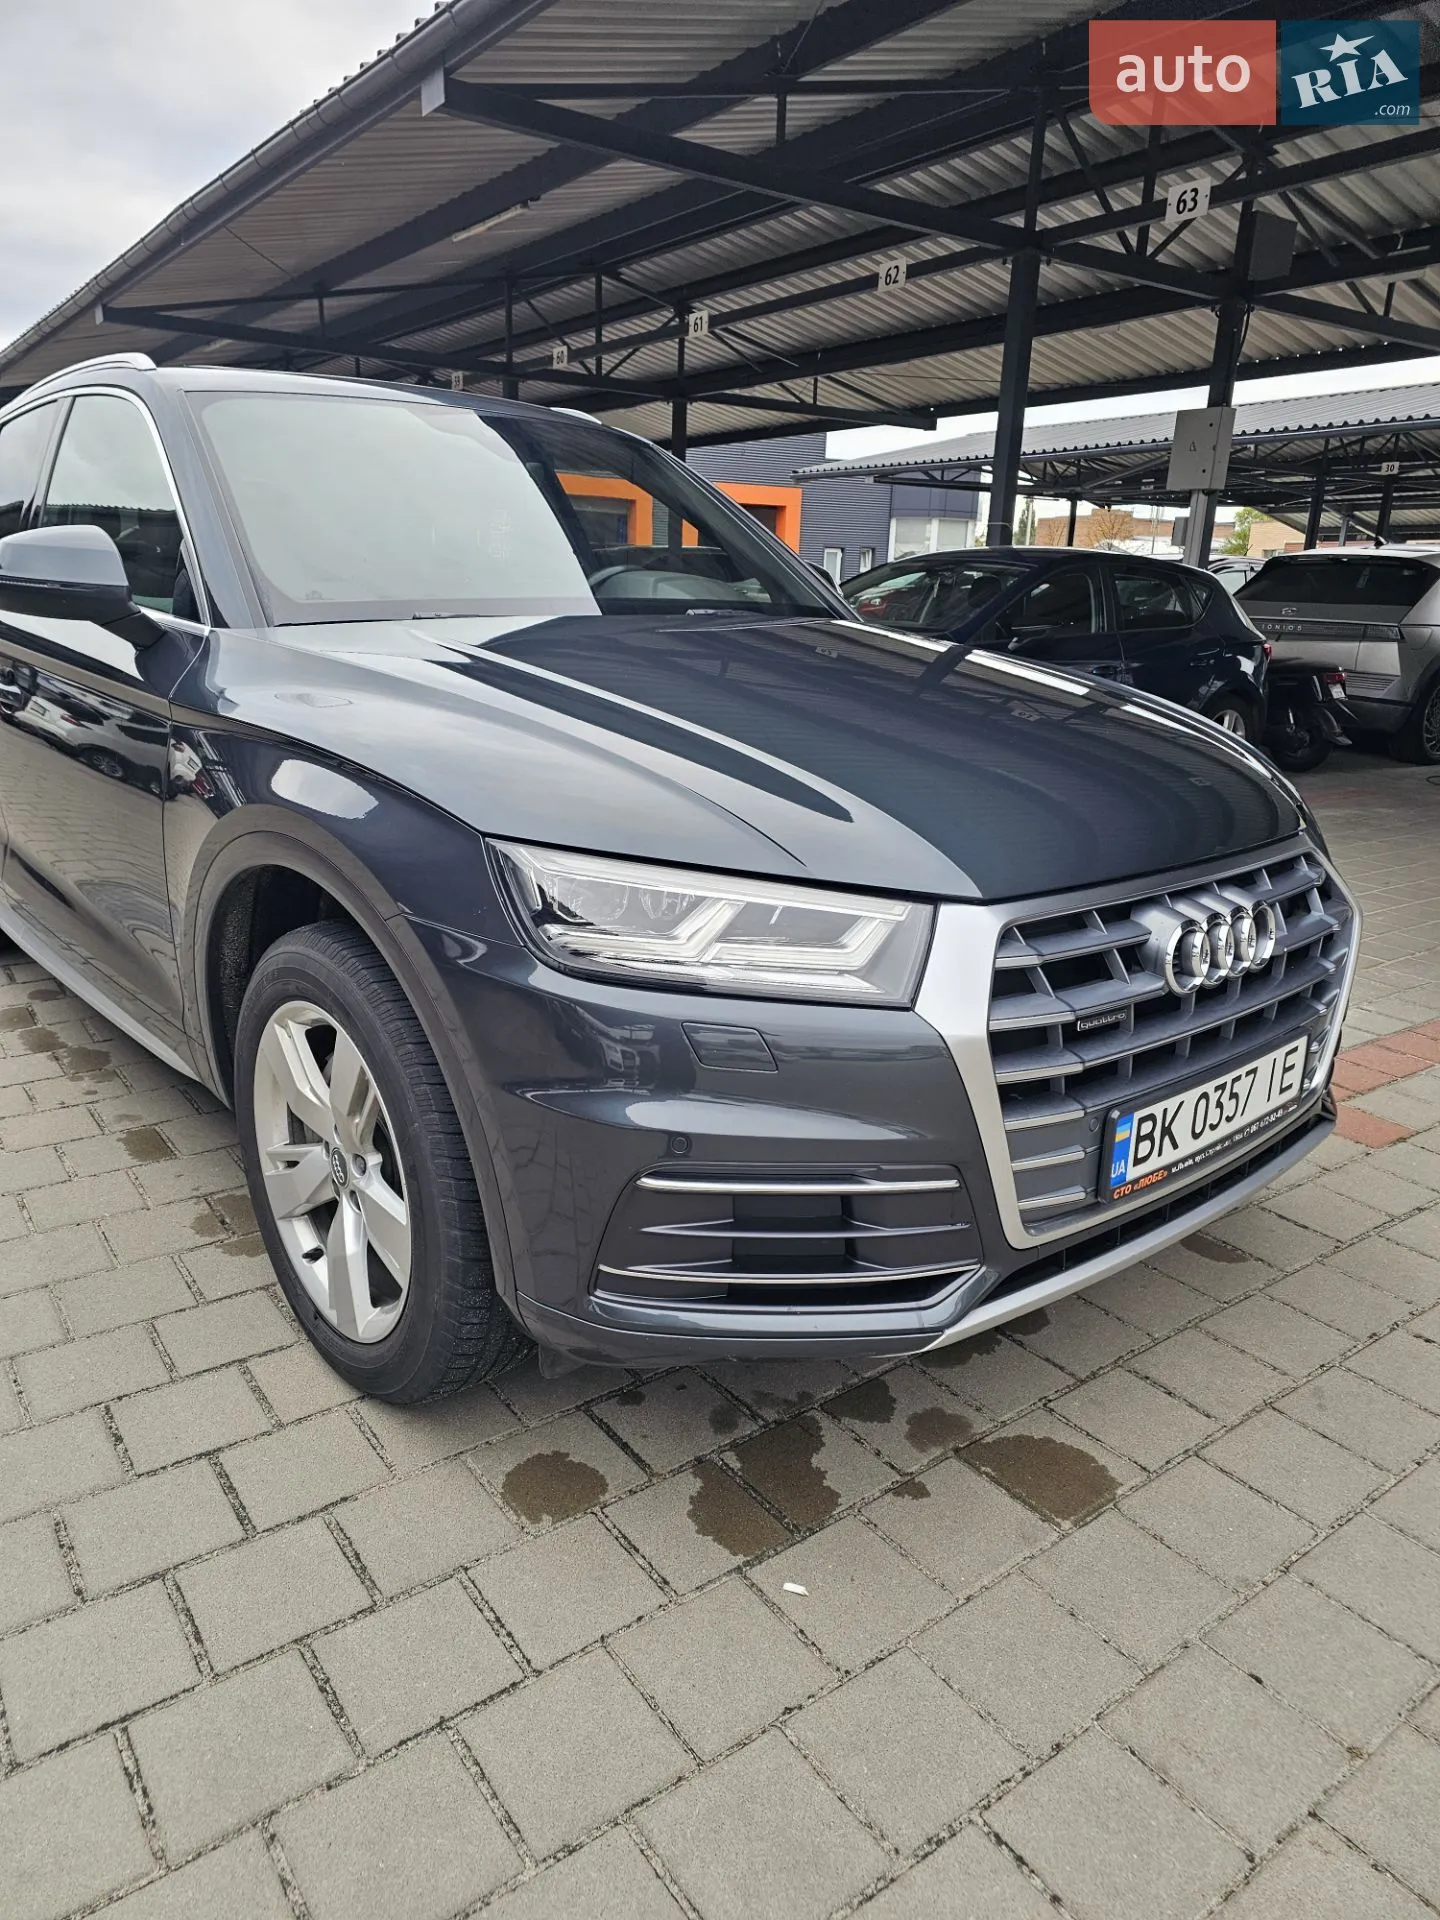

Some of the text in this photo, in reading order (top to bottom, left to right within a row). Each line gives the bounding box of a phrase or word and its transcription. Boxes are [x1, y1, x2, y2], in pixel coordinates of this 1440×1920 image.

[1175, 187, 1199, 215] 63
[884, 264, 900, 286] 62
[693, 315, 703, 333] 61
[1384, 463, 1395, 473] 30
[1080, 1012, 1126, 1030] quattro
[1132, 1099, 1185, 1168] BK
[1190, 1066, 1259, 1141] 0357
[1266, 1045, 1299, 1103] IE
[1111, 1159, 1126, 1178] UA
[1113, 1184, 1132, 1199] СТО
